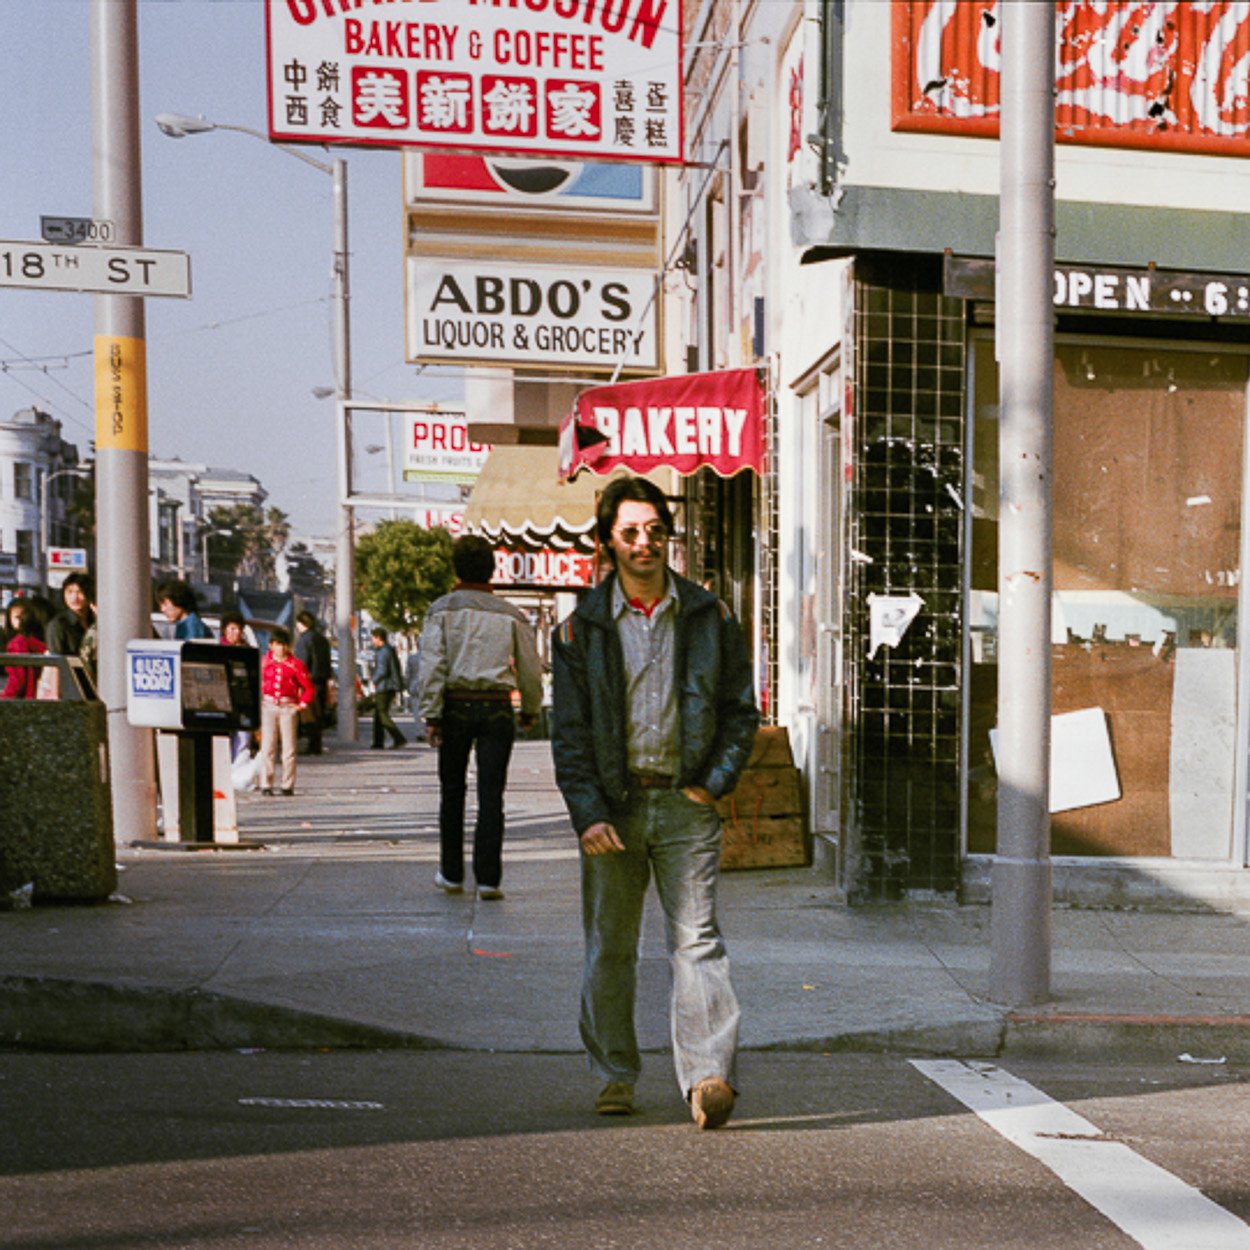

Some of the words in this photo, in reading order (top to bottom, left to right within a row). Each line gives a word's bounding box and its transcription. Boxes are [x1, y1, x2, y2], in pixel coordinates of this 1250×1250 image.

[344, 18, 459, 60] BAKERY
[469, 30, 483, 60] &
[494, 28, 604, 71] COFFEE
[355, 71, 600, 136] 美新餅家
[64, 220, 109, 240] 3400
[2, 251, 79, 278] 18TH
[108, 258, 156, 285] ST
[430, 274, 632, 321] ABDO'S
[423, 319, 505, 349] LIQUOR
[513, 324, 529, 350] &
[535, 325, 645, 356] GROCERY
[594, 406, 747, 456] BAKERY
